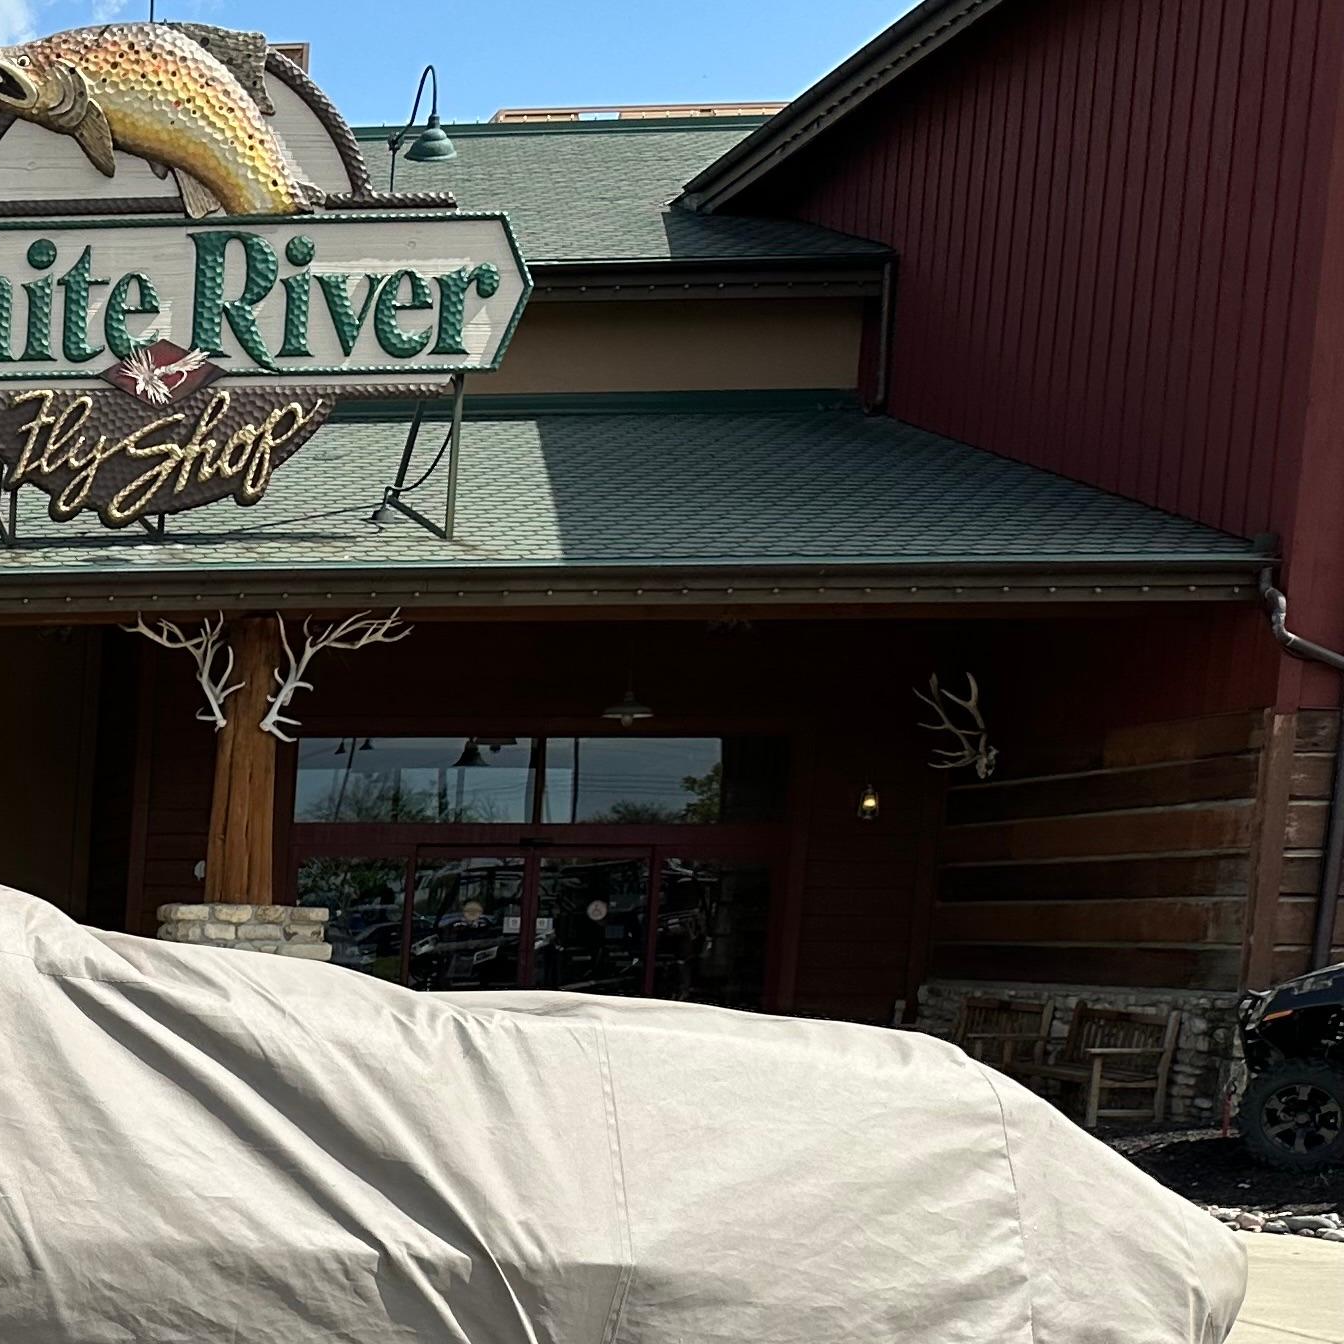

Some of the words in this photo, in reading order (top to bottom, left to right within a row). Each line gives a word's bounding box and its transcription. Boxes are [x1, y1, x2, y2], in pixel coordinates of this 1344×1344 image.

[189, 230, 500, 374] River
[9, 388, 112, 513] Fly
[108, 389, 324, 519] Shop
